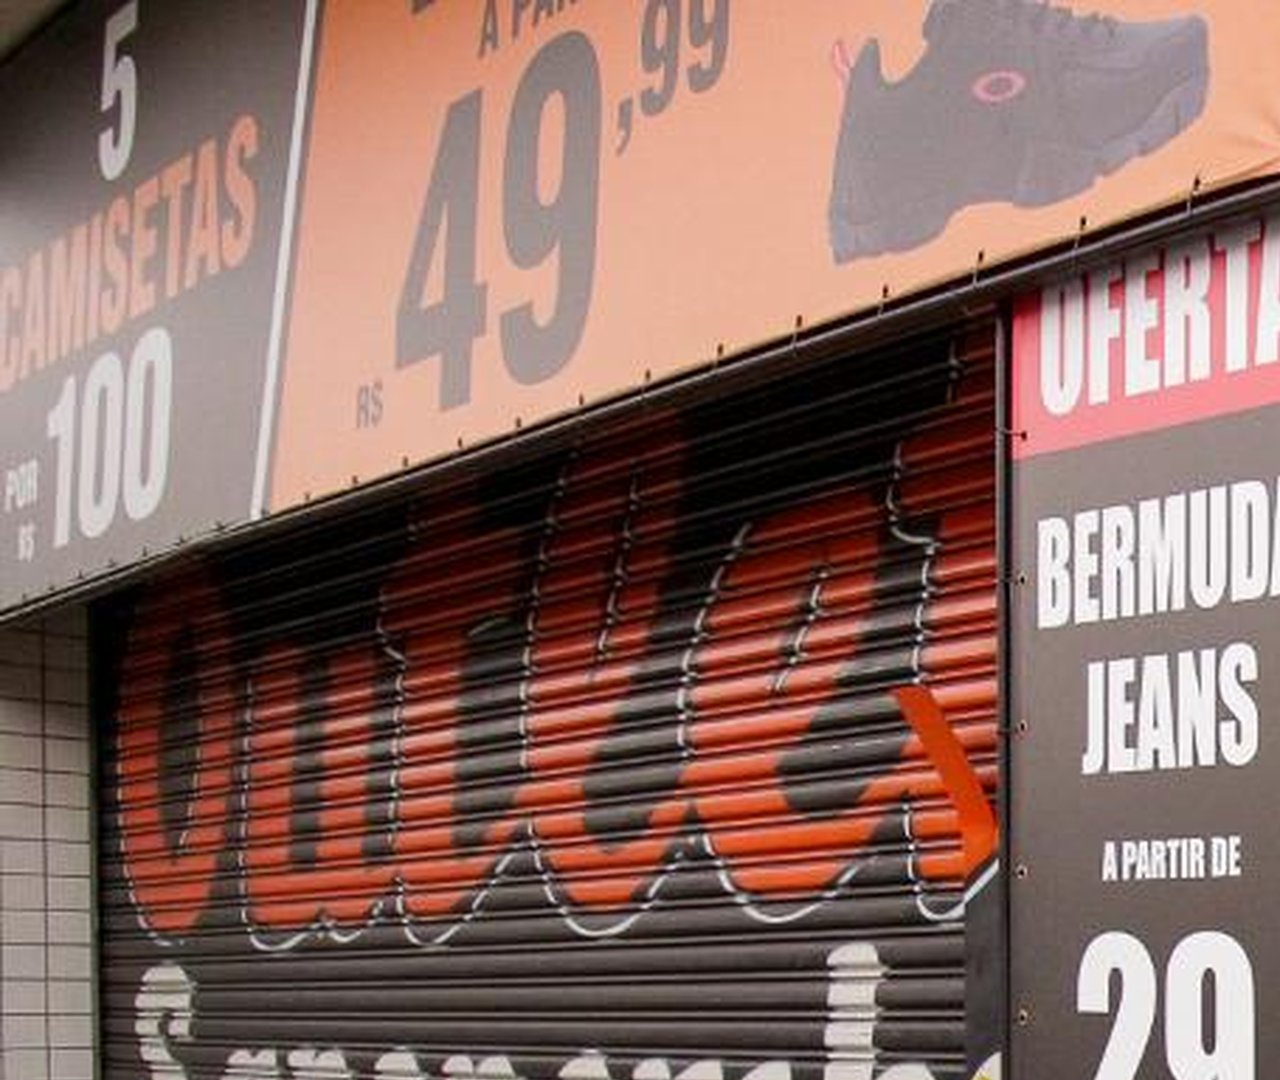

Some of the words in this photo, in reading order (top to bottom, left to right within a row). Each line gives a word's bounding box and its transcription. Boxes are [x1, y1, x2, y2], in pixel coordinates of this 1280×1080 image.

[99, 2, 139, 182] 5
[0, 114, 259, 393] CAMISETAS
[47, 327, 173, 548] 100
[1081, 643, 1259, 774] JEANS
[1102, 841, 1116, 882] A
[1121, 838, 1206, 880] PARTIR
[1210, 836, 1242, 877] DE
